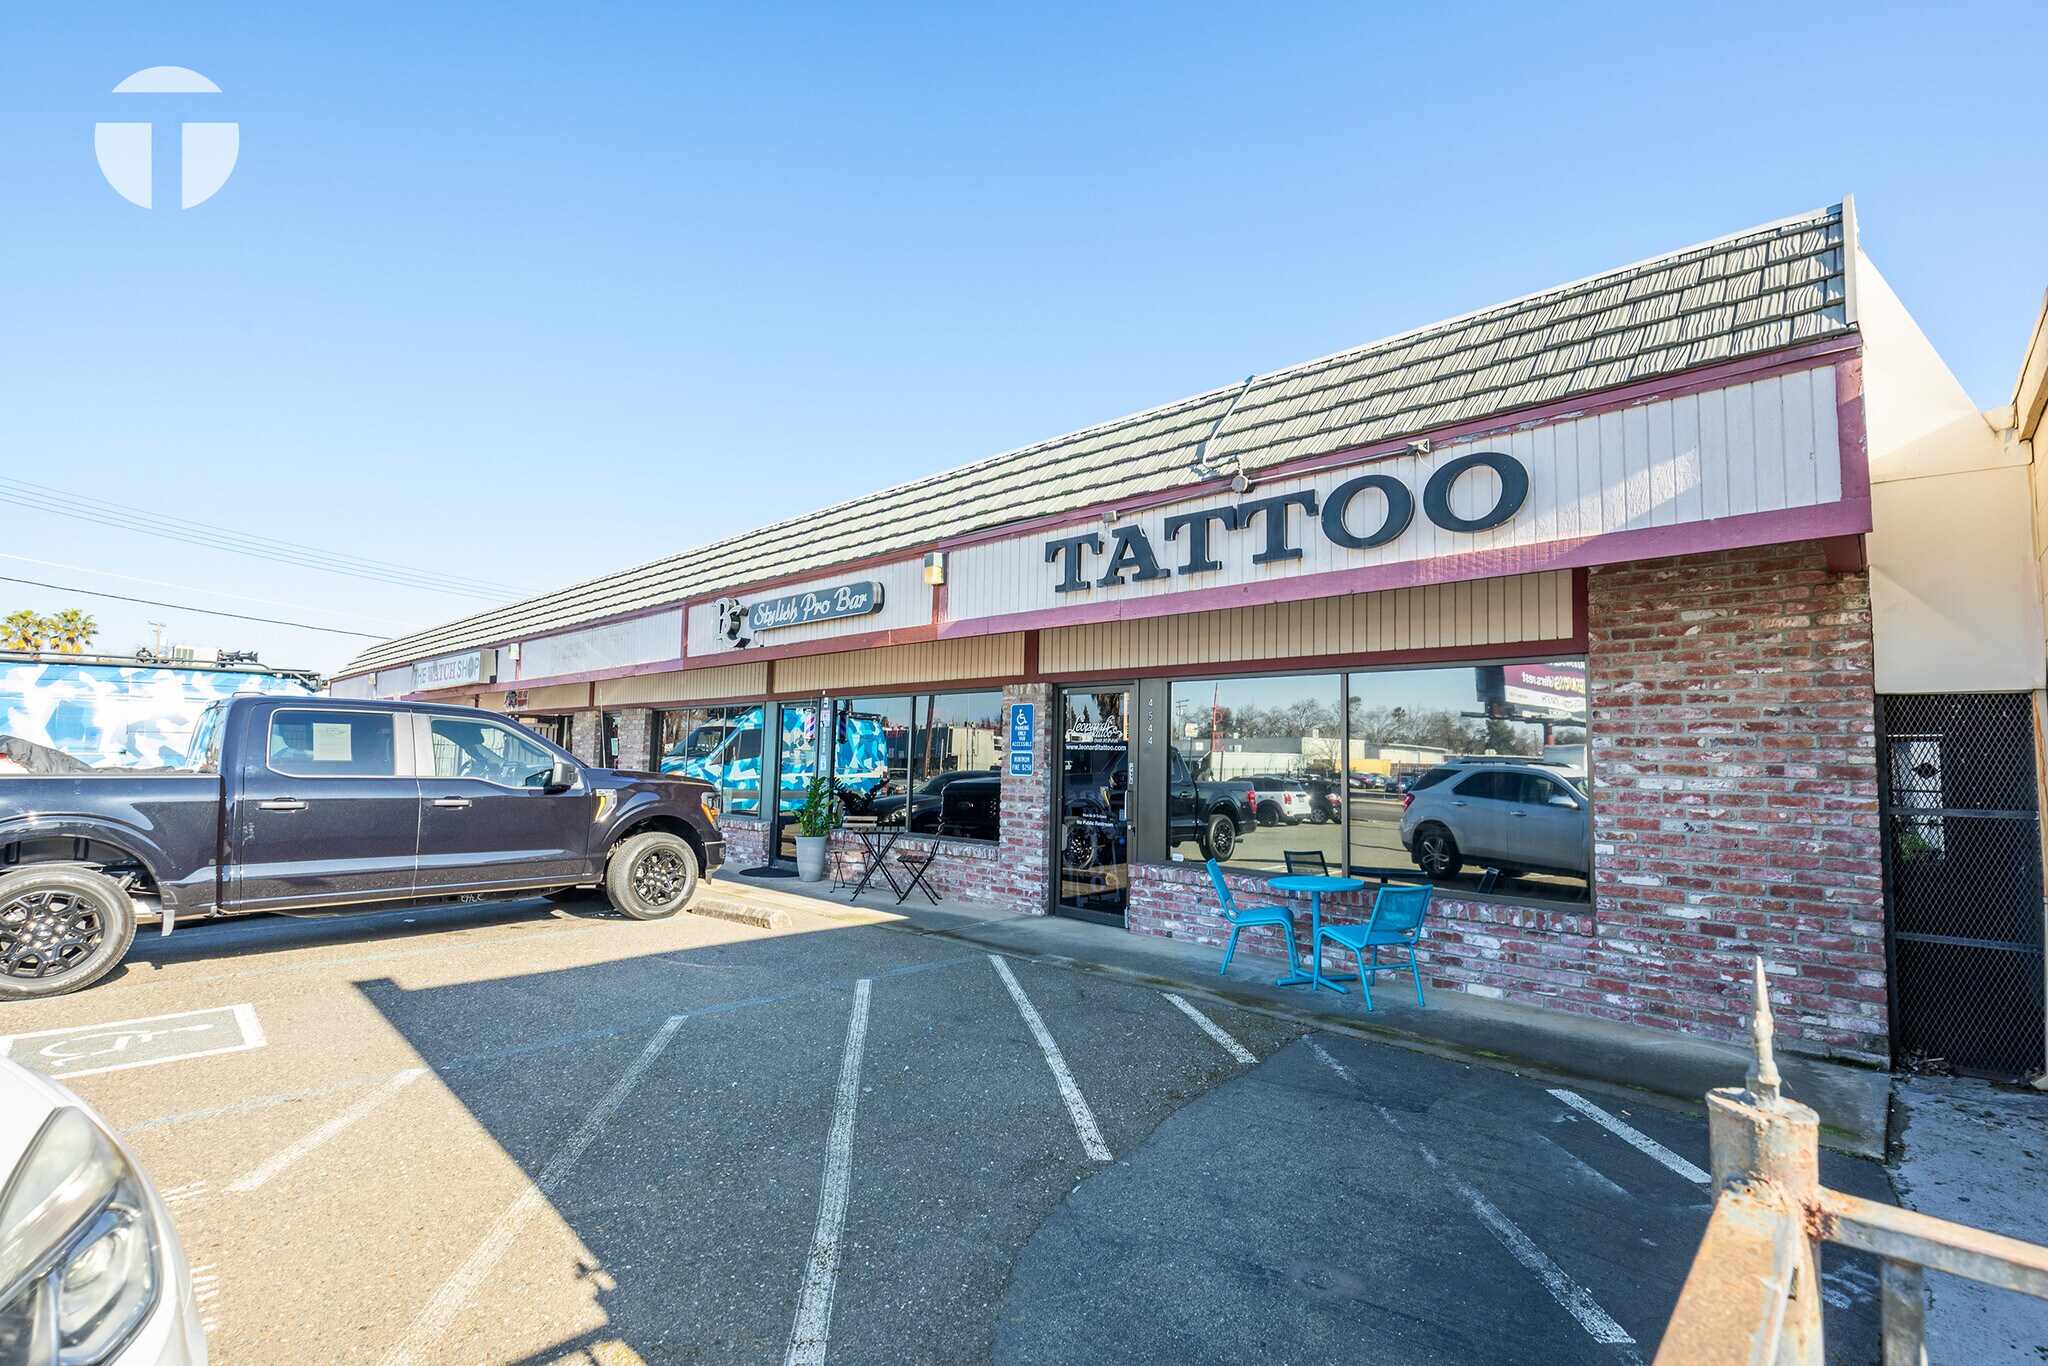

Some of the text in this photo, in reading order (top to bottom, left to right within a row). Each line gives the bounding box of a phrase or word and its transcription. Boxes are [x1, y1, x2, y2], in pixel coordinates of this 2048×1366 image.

[1045, 451, 1530, 593] TATTOO
[754, 586, 868, 627] Stylish Pro Bar
[412, 655, 480, 685] THE WATCH SHOP
